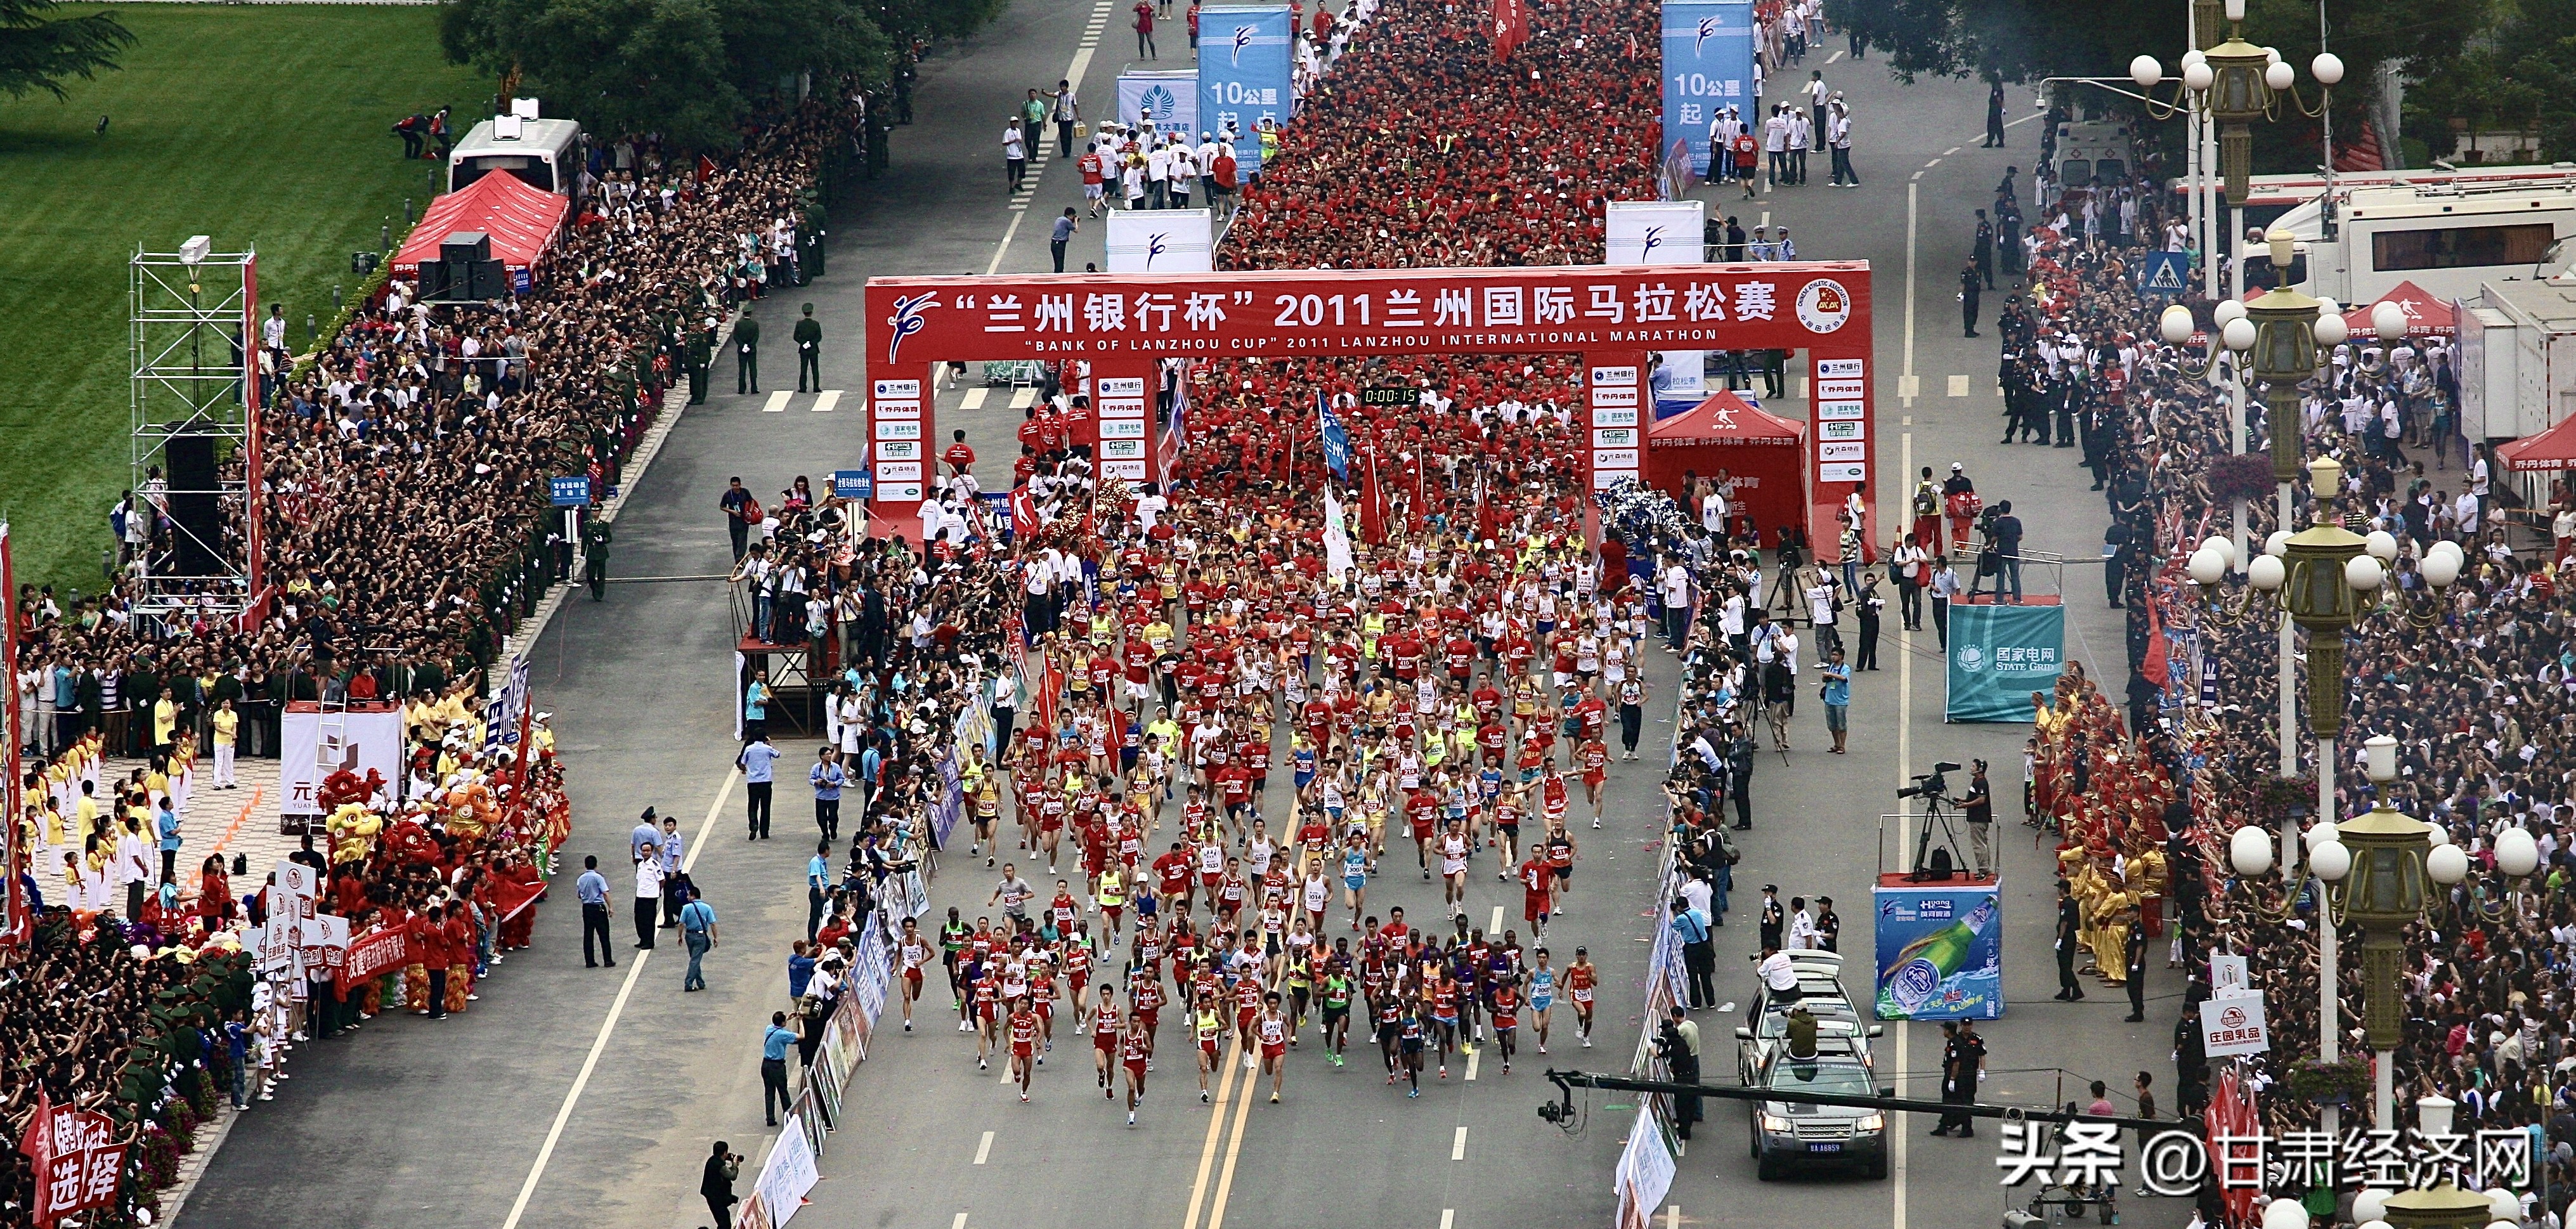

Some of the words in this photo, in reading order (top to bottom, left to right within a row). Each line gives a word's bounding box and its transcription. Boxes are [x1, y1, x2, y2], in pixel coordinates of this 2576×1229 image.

[1674, 73, 1741, 96] 10公里
[1211, 82, 1278, 105] 10公里
[1808, 280, 1828, 290] ATHLETIC
[1828, 282, 1849, 306] ASSOCIATION
[1273, 280, 1776, 327] 2011兰州国际马拉松赛
[1800, 314, 1847, 332] 中国田径协会
[1097, 340, 1119, 351] OF
[1131, 339, 1219, 350] LANZHOU
[1287, 337, 1328, 348] 2011
[1341, 335, 1429, 347] LANZHOU
[1441, 332, 1598, 346] INTERNATIONAL
[1610, 329, 1716, 341] MARATHON
[1366, 389, 1415, 402] 0:00:15
[1651, 438, 1695, 446] 乔丹体育
[1700, 437, 1744, 445] 乔丹体育
[1749, 437, 1794, 446] 乔丹体育
[2515, 459, 2563, 469] 乔丹体育
[1996, 647, 2055, 663] 国家电网
[1996, 662, 2027, 671] STATE
[2029, 662, 2054, 671] GRID
[2209, 1027, 2261, 1043] 庄园乳品
